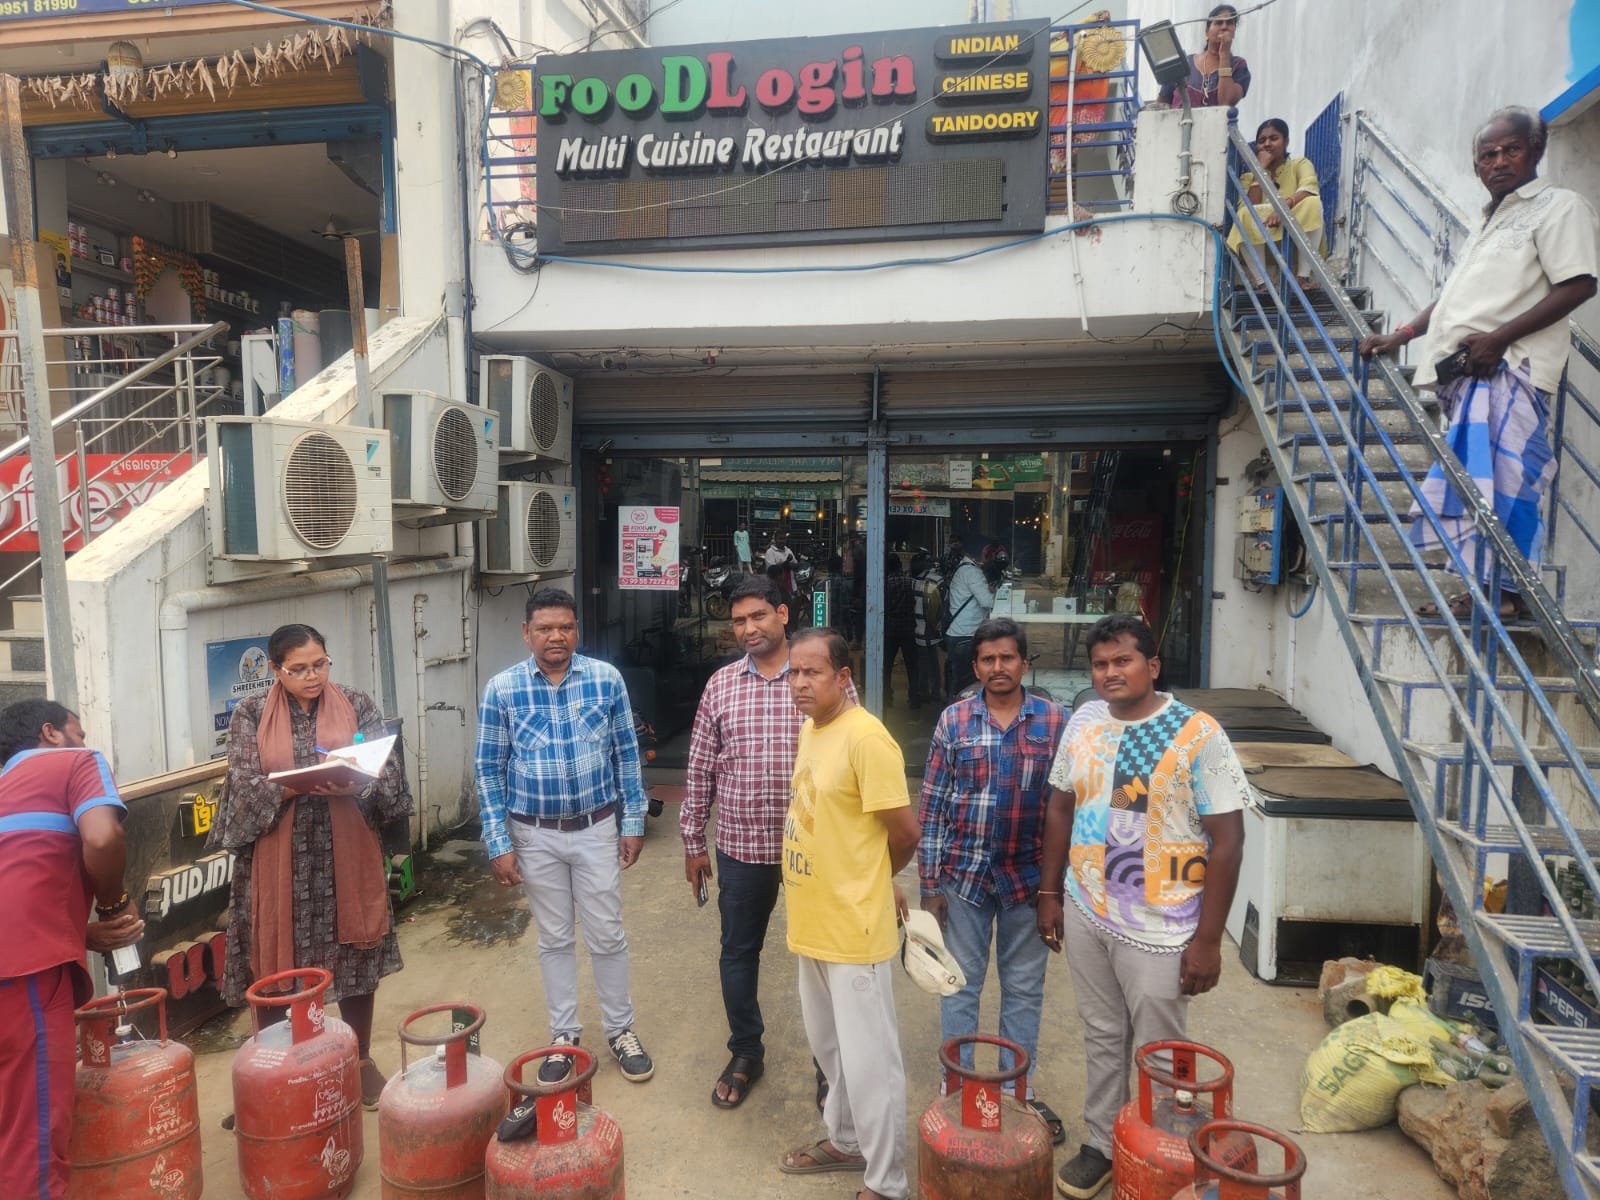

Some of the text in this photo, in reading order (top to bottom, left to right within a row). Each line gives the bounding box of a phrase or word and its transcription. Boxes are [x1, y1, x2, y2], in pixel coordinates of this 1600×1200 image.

[949, 34, 1020, 55] INDIAN
[942, 71, 1029, 92] CHINESE
[931, 110, 1039, 134] TANDOORY
[555, 120, 904, 173] Multi Cuisine Restaurant
[1549, 990, 1588, 1029] PEPSI
